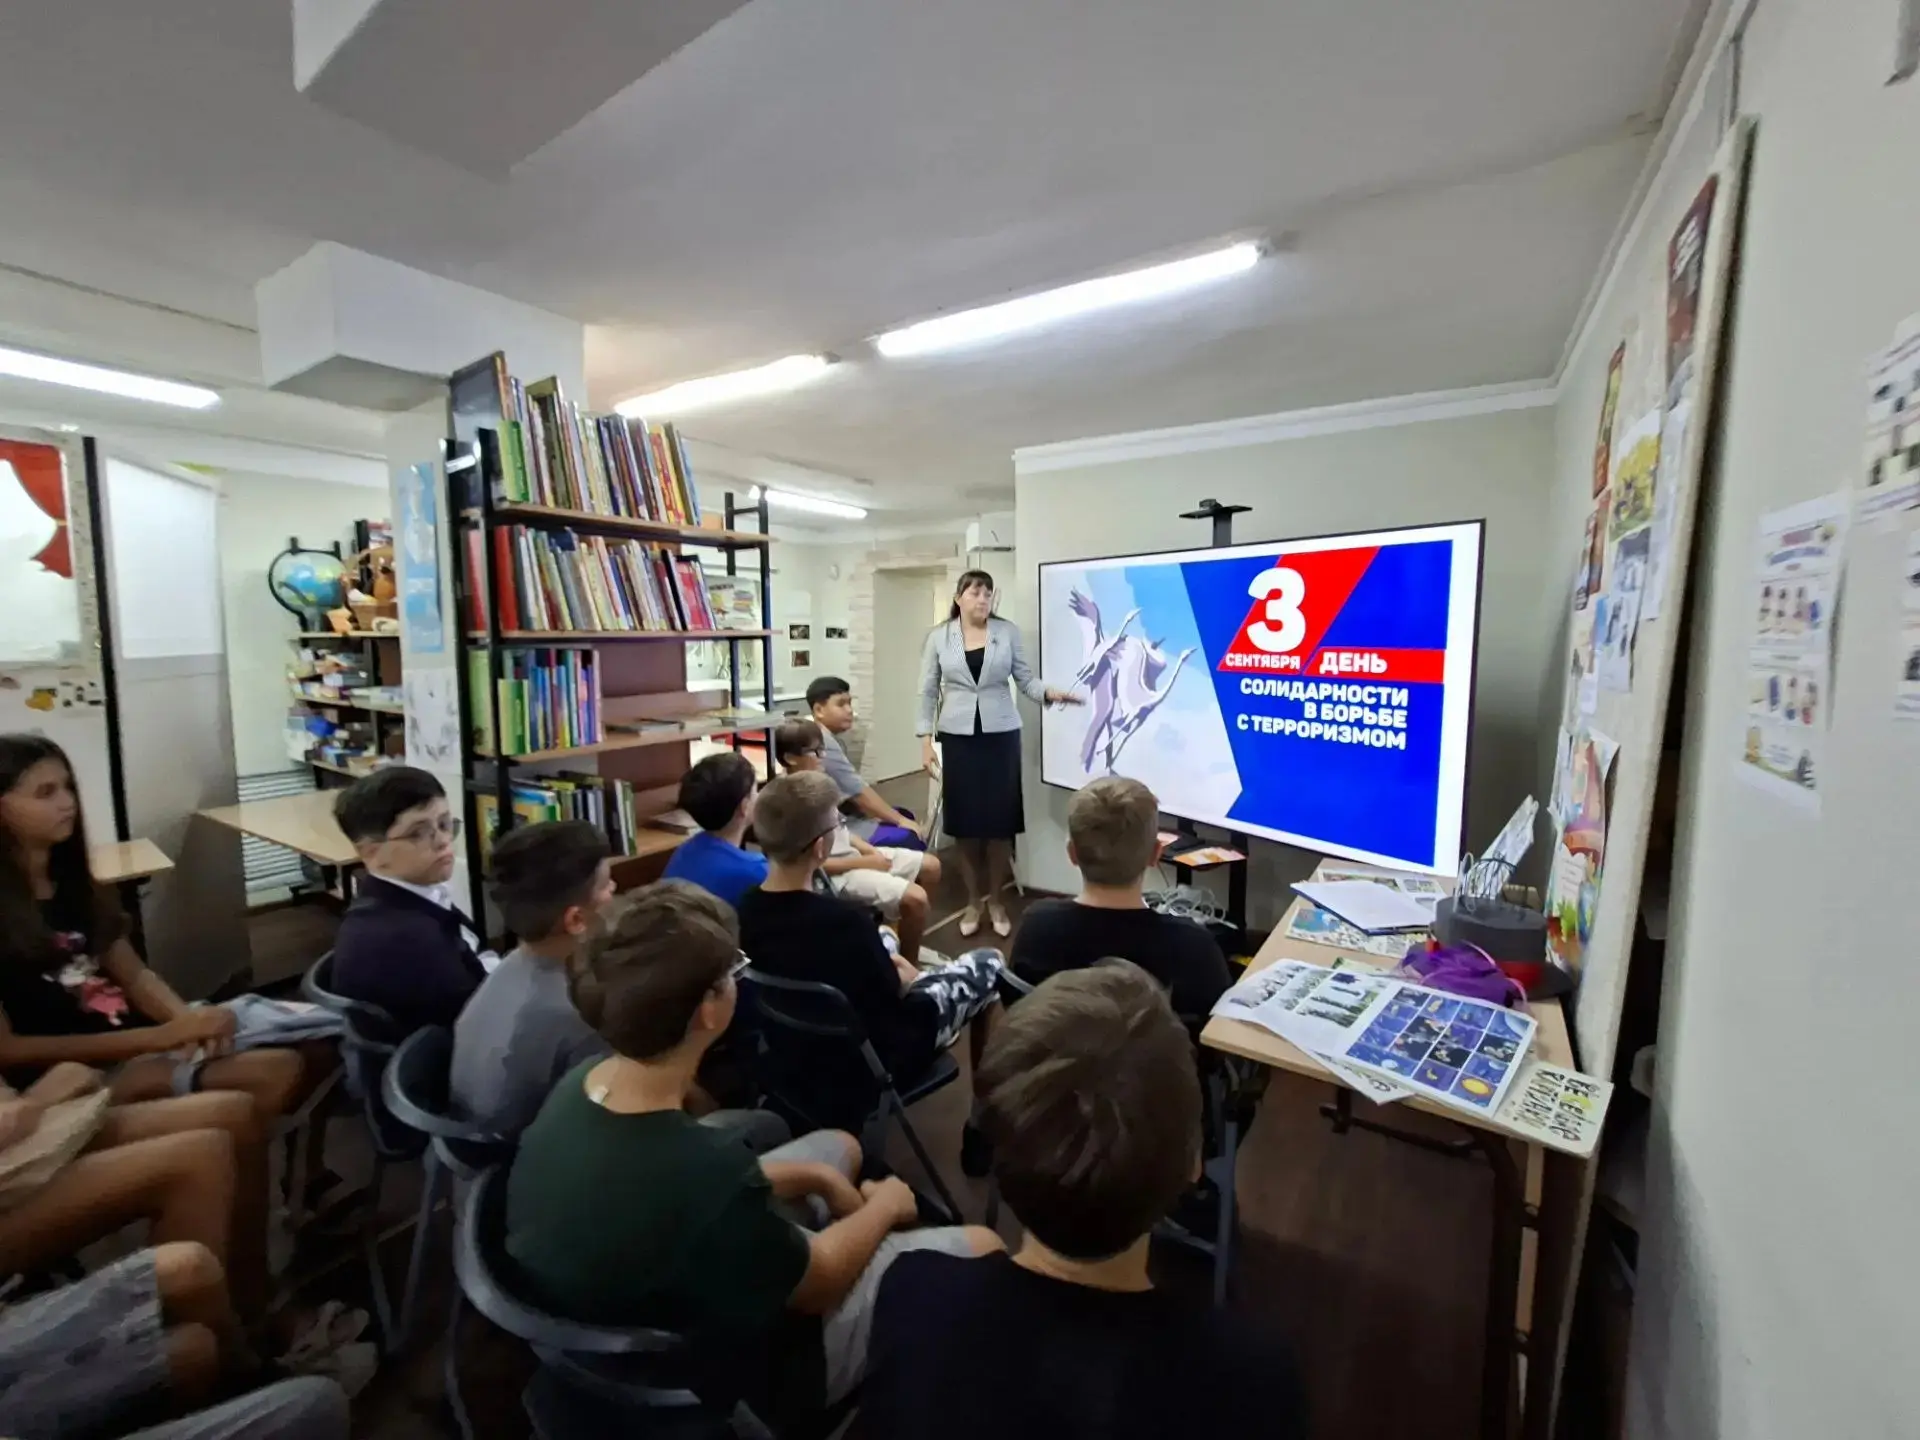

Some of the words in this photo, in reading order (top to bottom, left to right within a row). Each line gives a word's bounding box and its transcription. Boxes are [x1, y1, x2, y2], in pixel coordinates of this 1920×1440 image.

[1247, 567, 1306, 652] 3
[1225, 653, 1300, 670] СЕНТЯБРЯ
[1319, 652, 1387, 675] ДЕНЬ
[1240, 678, 1409, 707] СОЛИДАРНОСТИ
[1304, 702, 1317, 718] В
[1321, 703, 1407, 728] БОРЬБЕ
[1237, 714, 1248, 730] С
[1251, 715, 1406, 750] ТЕРРОРИЗМОМ
